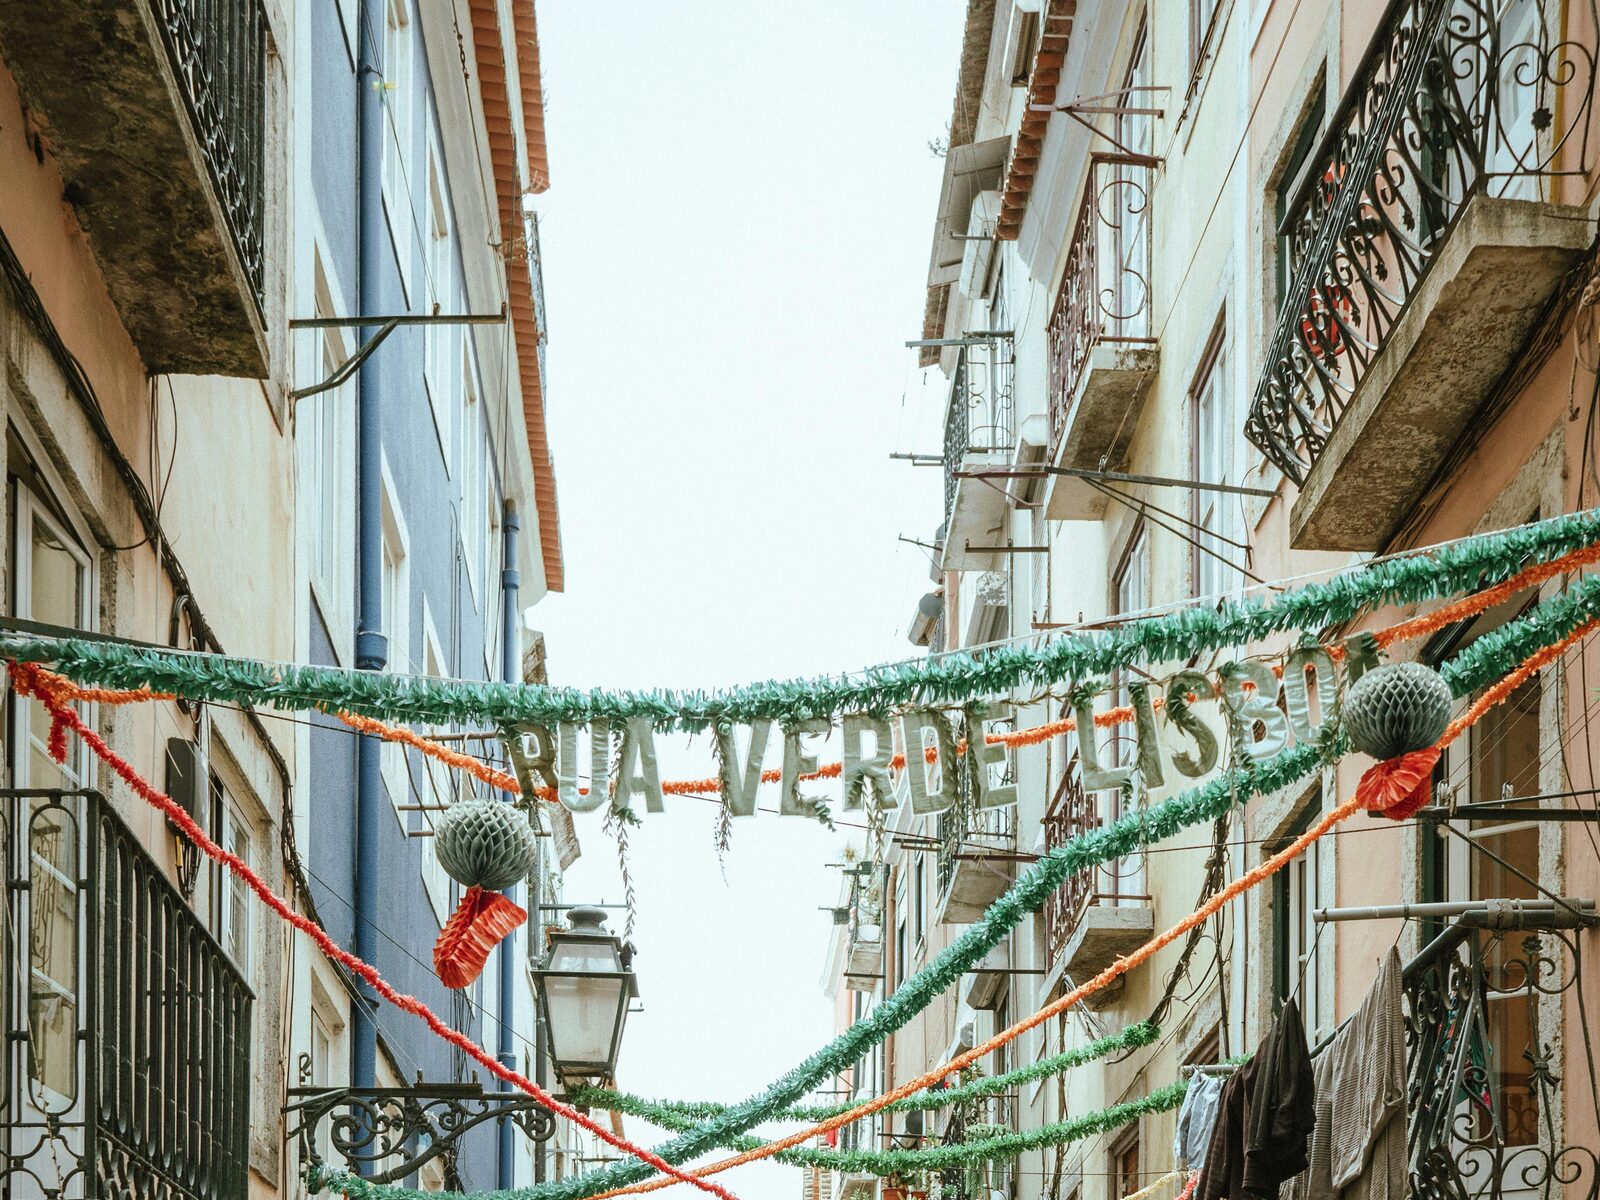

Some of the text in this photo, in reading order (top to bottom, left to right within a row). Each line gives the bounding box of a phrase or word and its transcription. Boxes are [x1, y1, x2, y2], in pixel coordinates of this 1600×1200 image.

[507, 632, 1380, 817] RUA VERDE LISBO
